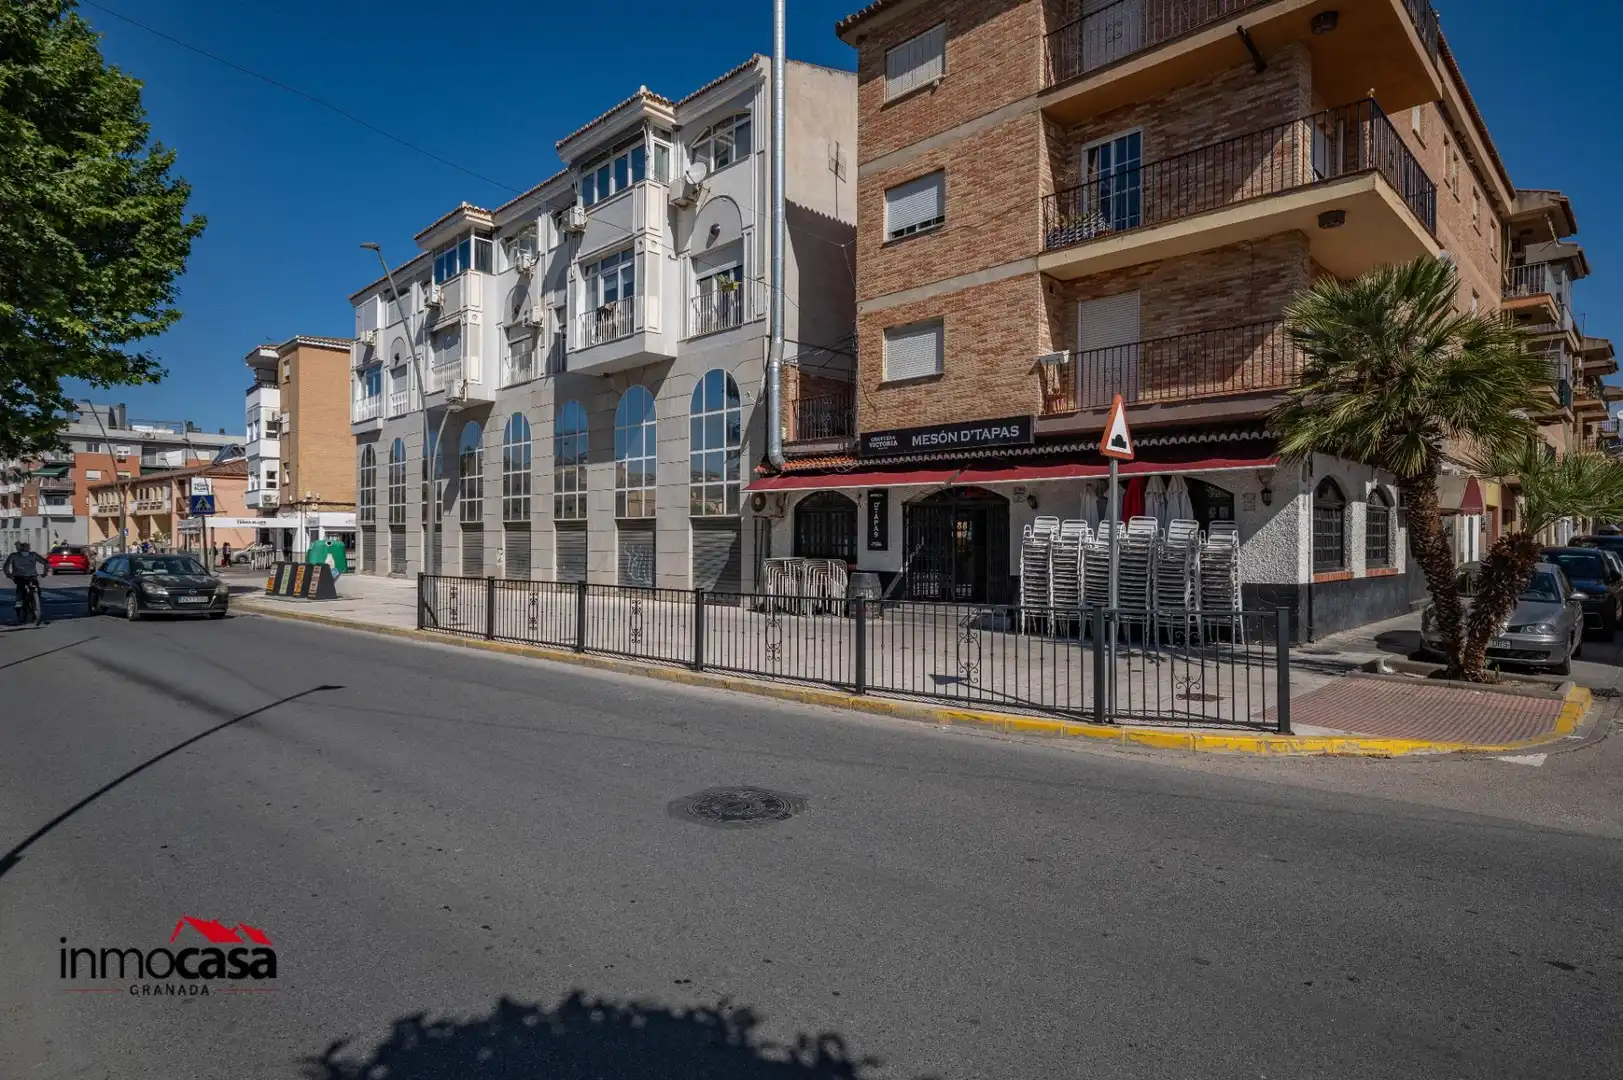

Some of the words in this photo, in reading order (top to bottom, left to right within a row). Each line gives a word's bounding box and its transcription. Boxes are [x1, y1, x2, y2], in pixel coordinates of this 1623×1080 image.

[912, 430, 958, 447] MESÓN
[960, 425, 1020, 441] D'TAPAS
[868, 440, 898, 448] VICTORIA
